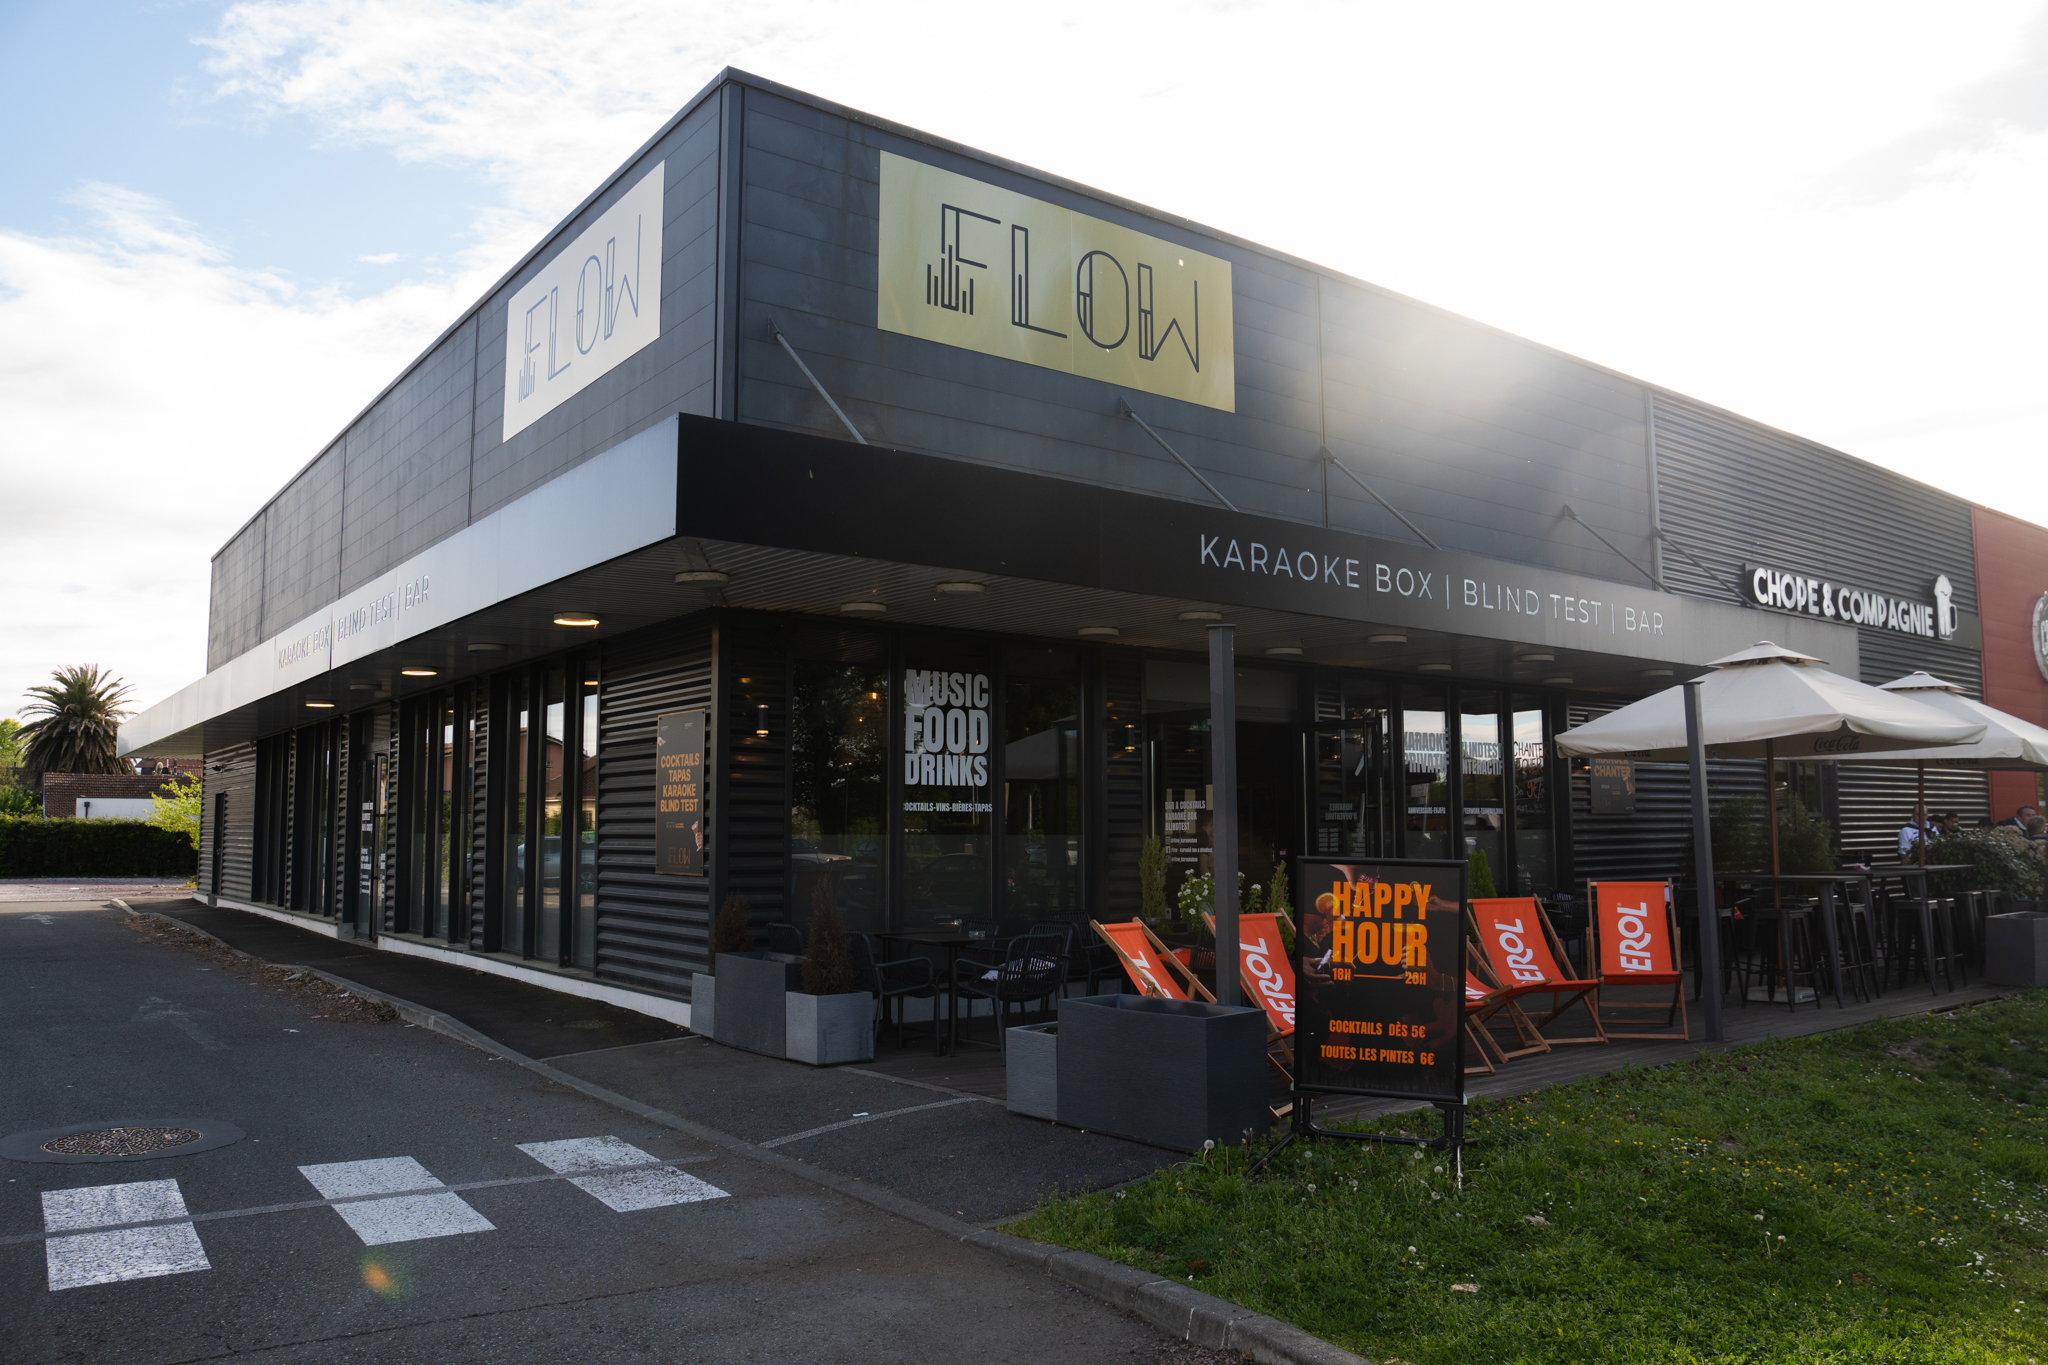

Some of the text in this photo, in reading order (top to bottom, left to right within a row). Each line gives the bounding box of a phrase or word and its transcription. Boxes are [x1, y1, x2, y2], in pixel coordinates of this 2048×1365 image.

[926, 203, 1199, 373] FLOW
[518, 214, 641, 403] FLOW
[1200, 533, 1360, 589] KARAOKE
[1374, 563, 1434, 601] BOX
[1464, 579, 1541, 617] BLIND
[1550, 593, 1602, 626] TEST
[1625, 606, 1664, 636] BAR
[1753, 568, 1935, 638] CHOPE & COMPAGNIE
[278, 634, 311, 670] KARAOKE
[312, 623, 330, 654] BOX
[337, 606, 366, 642] BLIND
[369, 592, 394, 627] TEST
[404, 574, 430, 611] BAR
[906, 668, 989, 709] MUSIC
[905, 706, 990, 754] FOOD
[1514, 740, 1550, 760] CHANTER
[1814, 734, 1862, 753] Coca-Cola
[660, 752, 700, 769] COCKTAILS
[904, 754, 988, 787] DRINKS
[1463, 759, 1503, 776] NTERACTIF
[1514, 757, 1544, 774] JOUER
[668, 769, 691, 782] TAPAS
[1594, 764, 1631, 778] CHANTER
[662, 783, 696, 798] KARAOKE
[660, 799, 698, 812] BLIND TEST
[1165, 801, 1175, 810] BAR
[1180, 800, 1206, 809] COCKTAILS
[1165, 822, 1190, 830] BLINDTEST
[1332, 880, 1432, 920] HAPPY
[1332, 920, 1428, 967] HOUR
[1616, 902, 1652, 972] EROL
[1494, 917, 1546, 984] EROL
[1332, 968, 1426, 985] 18H 20H
[1329, 1020, 1426, 1038] COCKTAILS DÈS 5€
[1320, 1045, 1435, 1066] TOUTES LES PINTES 6€
